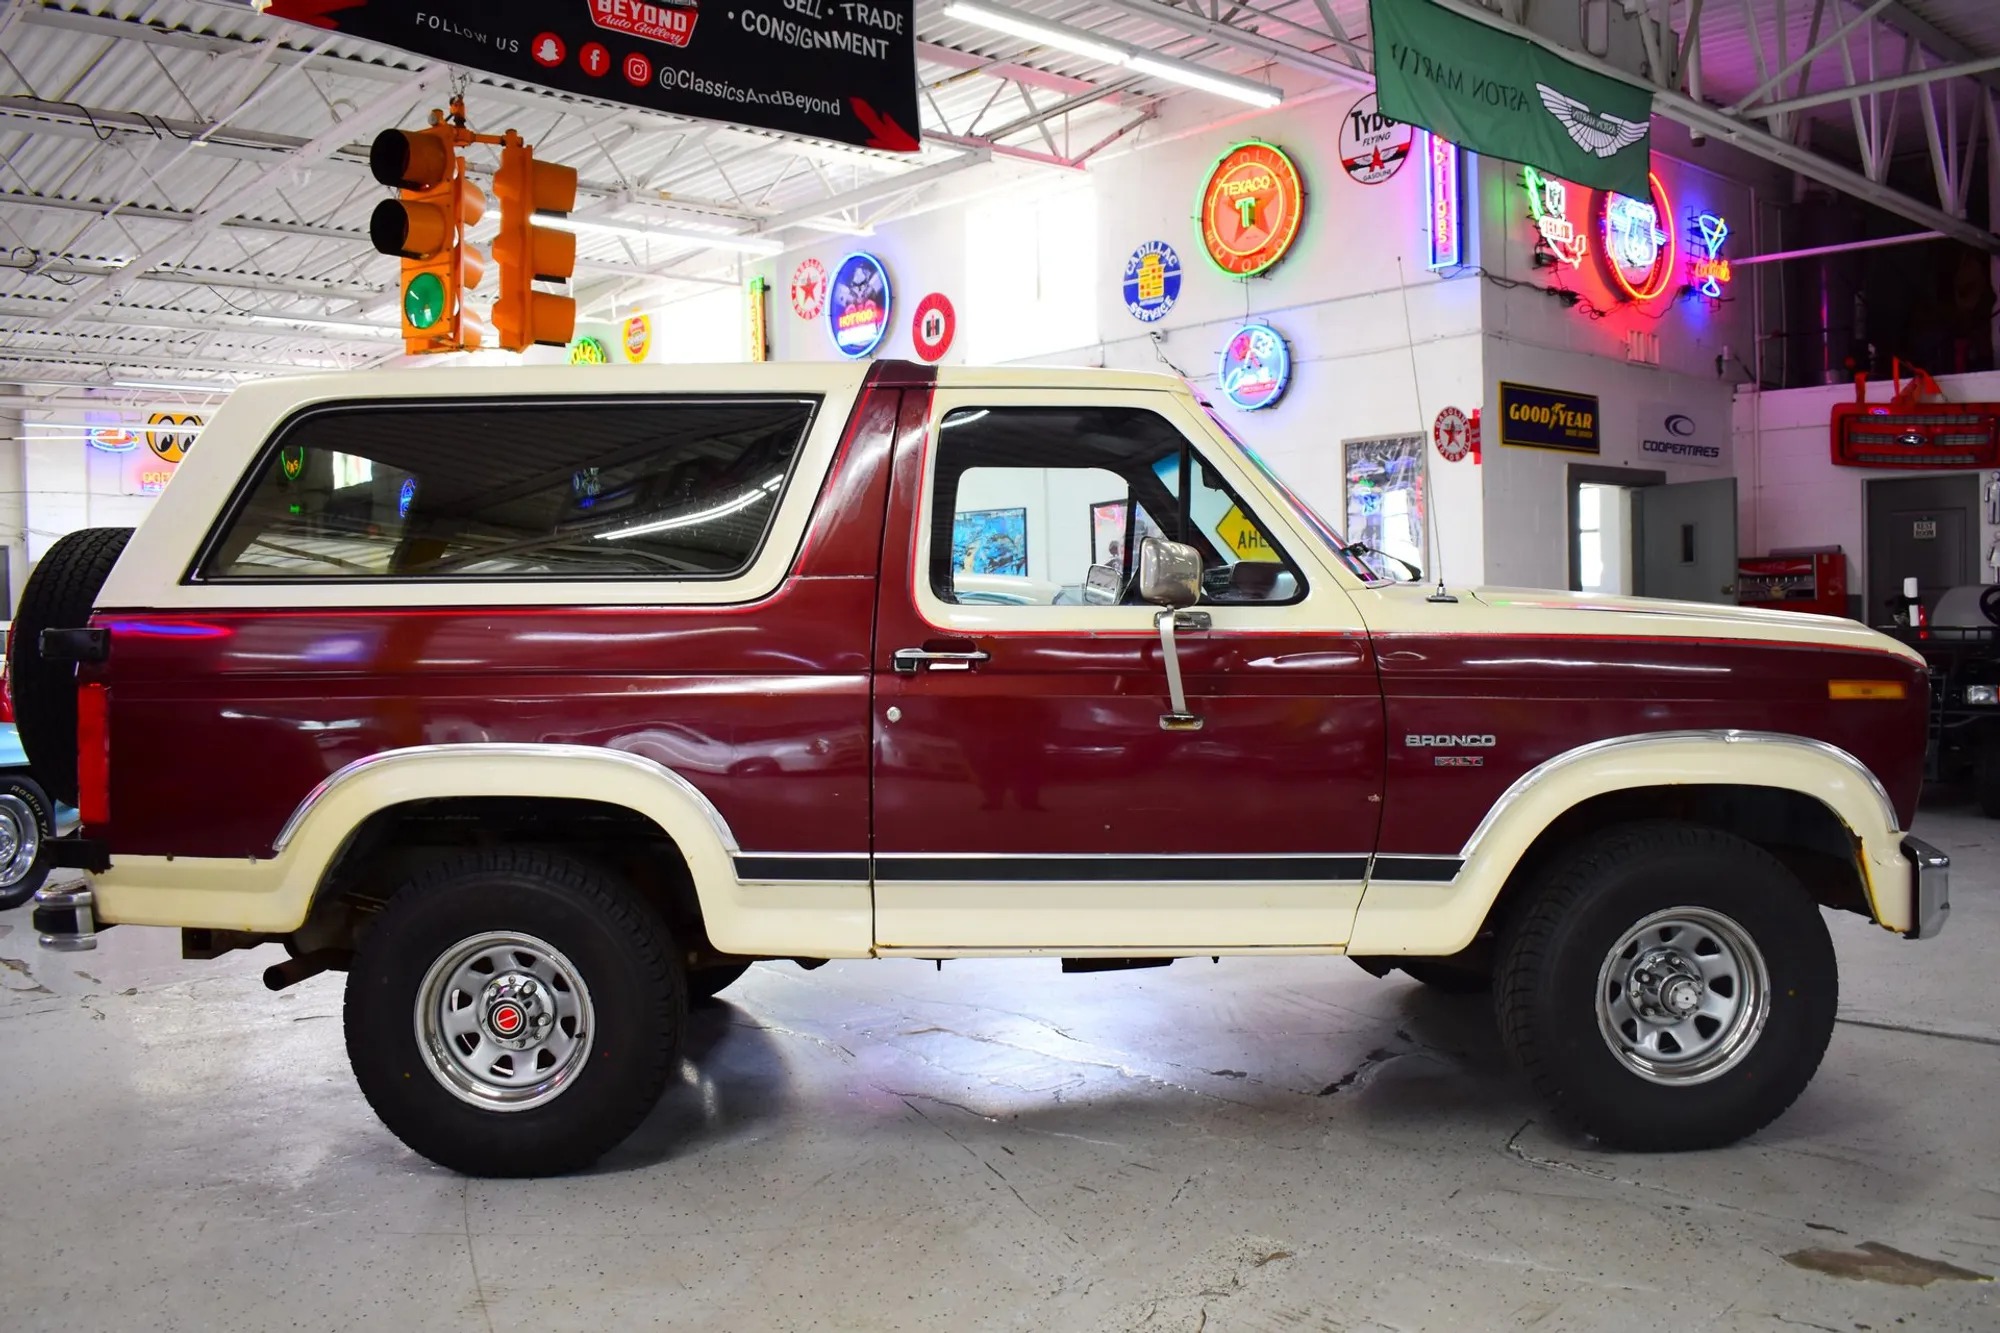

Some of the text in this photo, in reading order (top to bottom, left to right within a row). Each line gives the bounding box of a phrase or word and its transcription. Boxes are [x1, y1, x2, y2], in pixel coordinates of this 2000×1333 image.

[416, 12, 520, 53] FOLLOW US
[598, 13, 684, 45] Auto Gallery
[741, 9, 890, 60] CONSIGNMENT
[839, 3, 904, 35] TRADE
[659, 66, 841, 116] @ClassicsAndBeyond
[1362, 132, 1391, 147] FLYING
[1221, 175, 1270, 197] TEXACO
[1362, 169, 1392, 181] GASOLINE
[1126, 241, 1178, 276] CADILLAC
[1129, 295, 1174, 321] SERVICE
[1405, 734, 1496, 747] BRONCO
